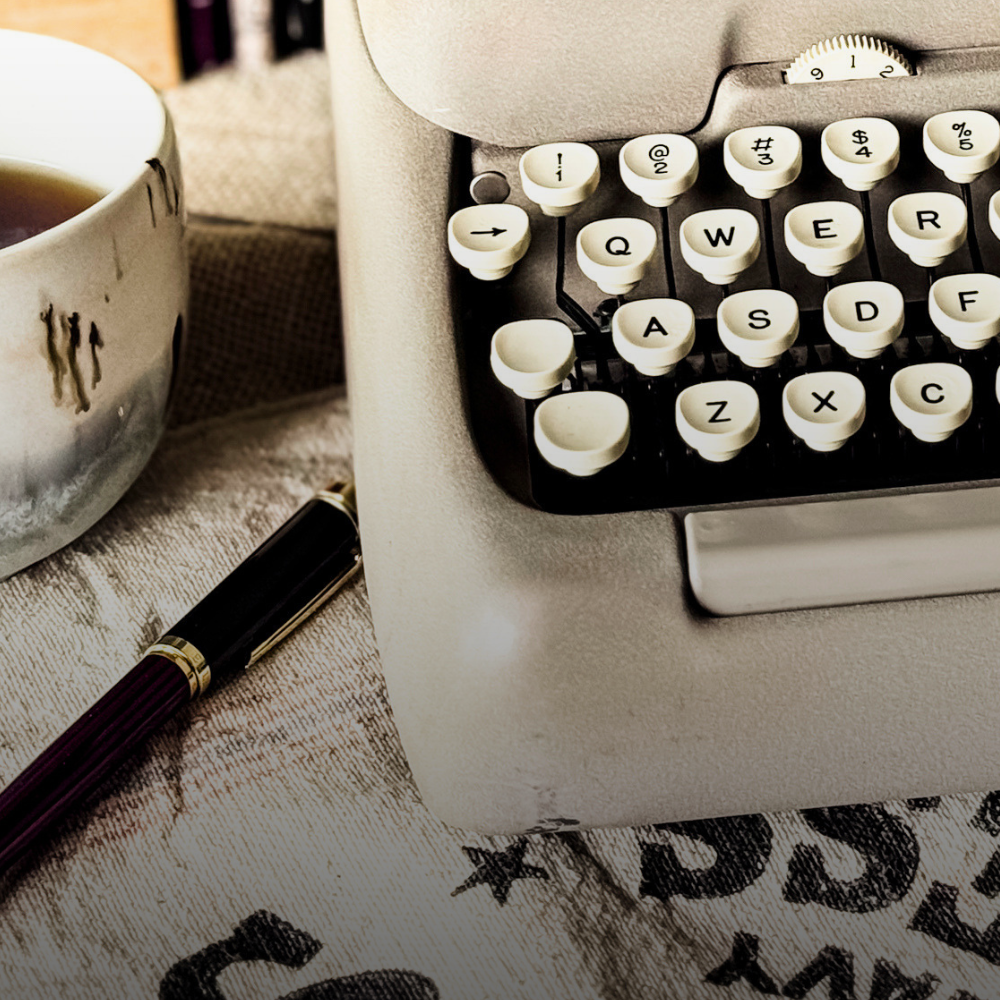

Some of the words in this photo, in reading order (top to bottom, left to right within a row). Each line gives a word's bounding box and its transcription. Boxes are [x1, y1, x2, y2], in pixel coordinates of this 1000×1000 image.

[852, 130, 868, 144] $
[952, 123, 971, 138] %
[649, 144, 669, 161] @
[855, 146, 872, 157] 4
[960, 139, 973, 150] 5
[654, 162, 667, 174] 2
[758, 154, 773, 165] 3
[813, 219, 837, 239] E
[916, 211, 941, 230] R
[605, 237, 631, 255] Q
[704, 227, 735, 247] W
[855, 301, 878, 321] D
[958, 291, 978, 312] F
[643, 317, 668, 338] A
[748, 310, 771, 329] S
[812, 391, 838, 413] X
[921, 383, 944, 404] C
[706, 401, 731, 423] Z
